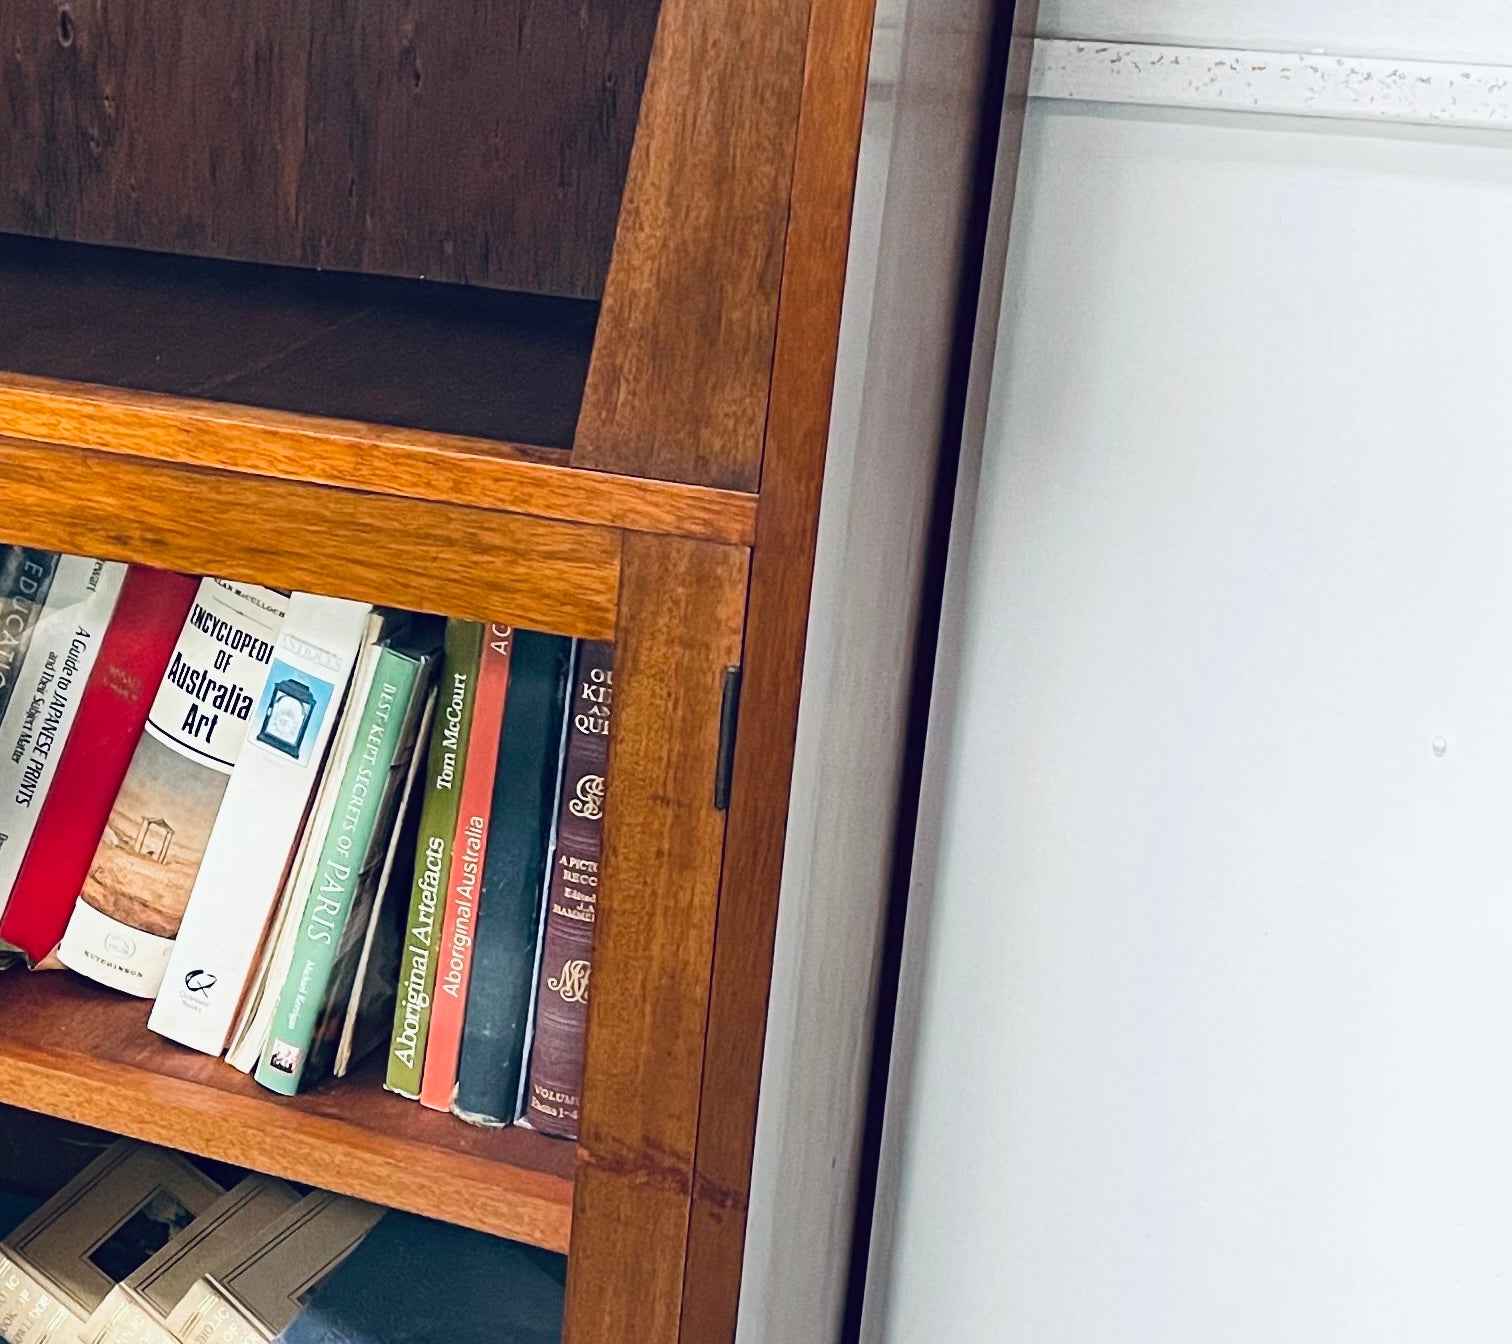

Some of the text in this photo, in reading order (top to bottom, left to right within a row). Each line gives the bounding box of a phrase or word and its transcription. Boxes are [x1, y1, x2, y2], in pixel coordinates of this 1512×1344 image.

[214, 649, 233, 673] OF
[11, 651, 58, 764] and Their Subject Matter
[16, 625, 91, 808] A Guide to JAPANESE PRINTS
[181, 703, 219, 744] Art
[363, 682, 397, 765] BEST-KEPT
[344, 768, 372, 832] SECRETS
[336, 835, 353, 858] OF
[393, 673, 468, 1069] Aboriginal Artefacts Tom McCourt
[558, 855, 569, 866] A
[307, 859, 353, 946] PARIS
[442, 815, 484, 998] Aboriginal Australia
[84, 949, 144, 978] HUTCHINSON
